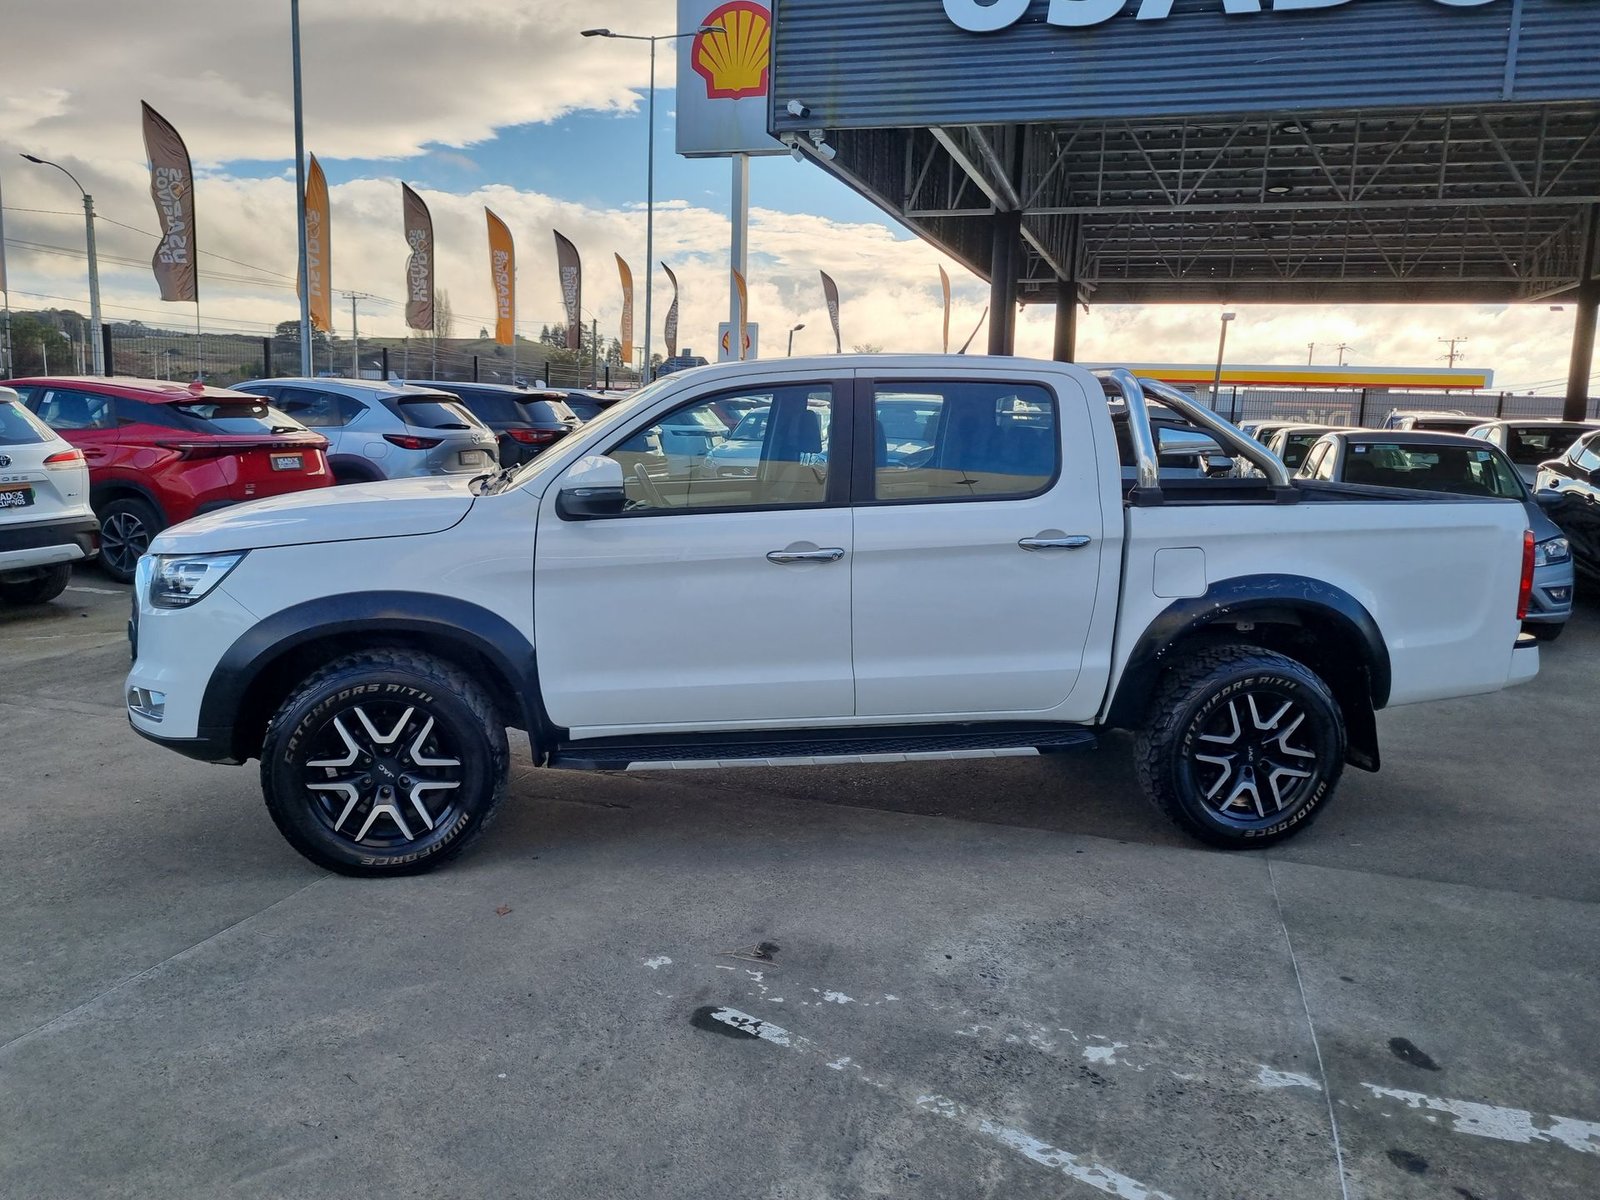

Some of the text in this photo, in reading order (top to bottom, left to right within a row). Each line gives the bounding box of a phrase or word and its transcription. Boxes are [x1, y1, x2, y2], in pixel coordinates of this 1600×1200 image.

[284, 683, 380, 764] CATCHFORS
[378, 764, 395, 778] JAC
[1244, 780, 1328, 838] WINDFORCE
[360, 811, 470, 867] WINDFORCE
